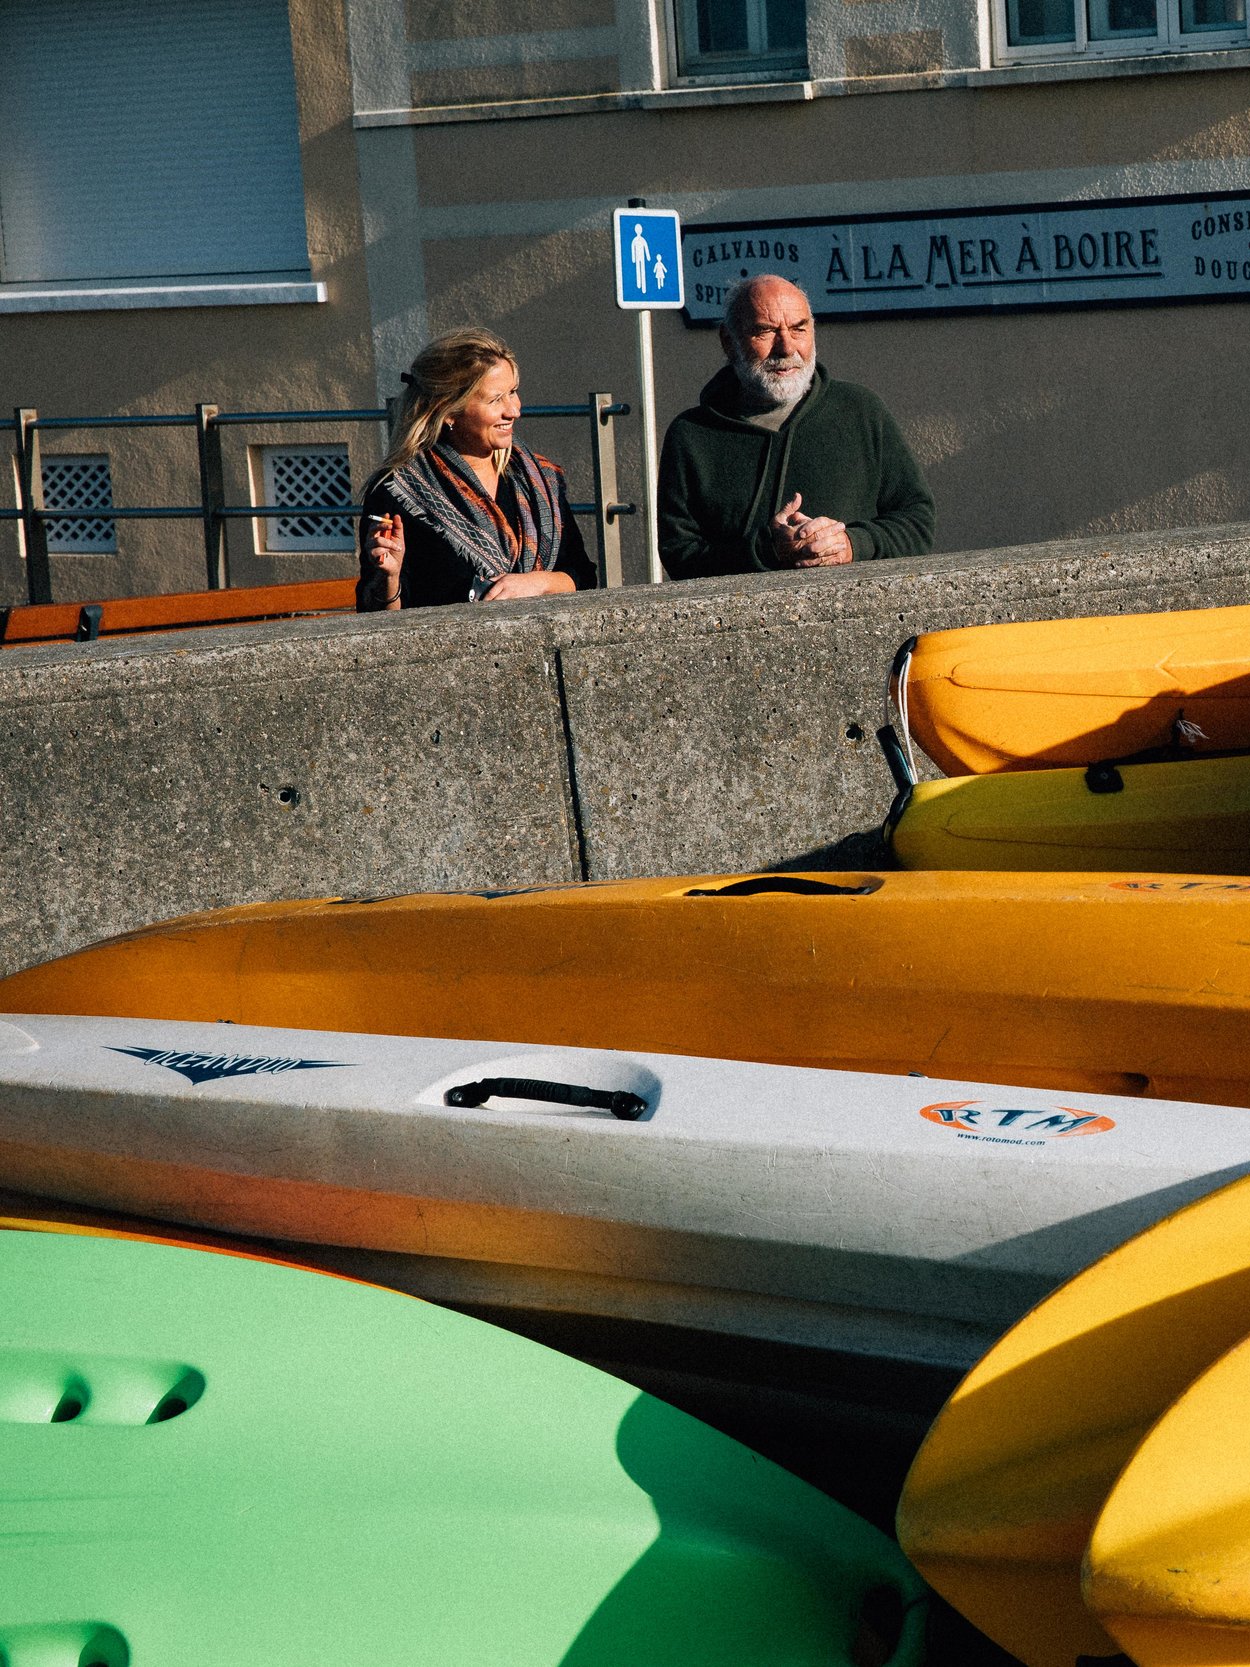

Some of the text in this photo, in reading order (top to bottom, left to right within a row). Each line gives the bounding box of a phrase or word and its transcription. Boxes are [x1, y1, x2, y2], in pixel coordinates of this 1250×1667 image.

[692, 239, 800, 268] CALVADOS
[825, 234, 849, 282] À
[861, 244, 911, 280] LA
[1015, 221, 1041, 272] À
[1053, 228, 1162, 271] BOIRE
[930, 1108, 1101, 1134] RTM
[956, 1131, 1047, 1147] www.rotomod.com
